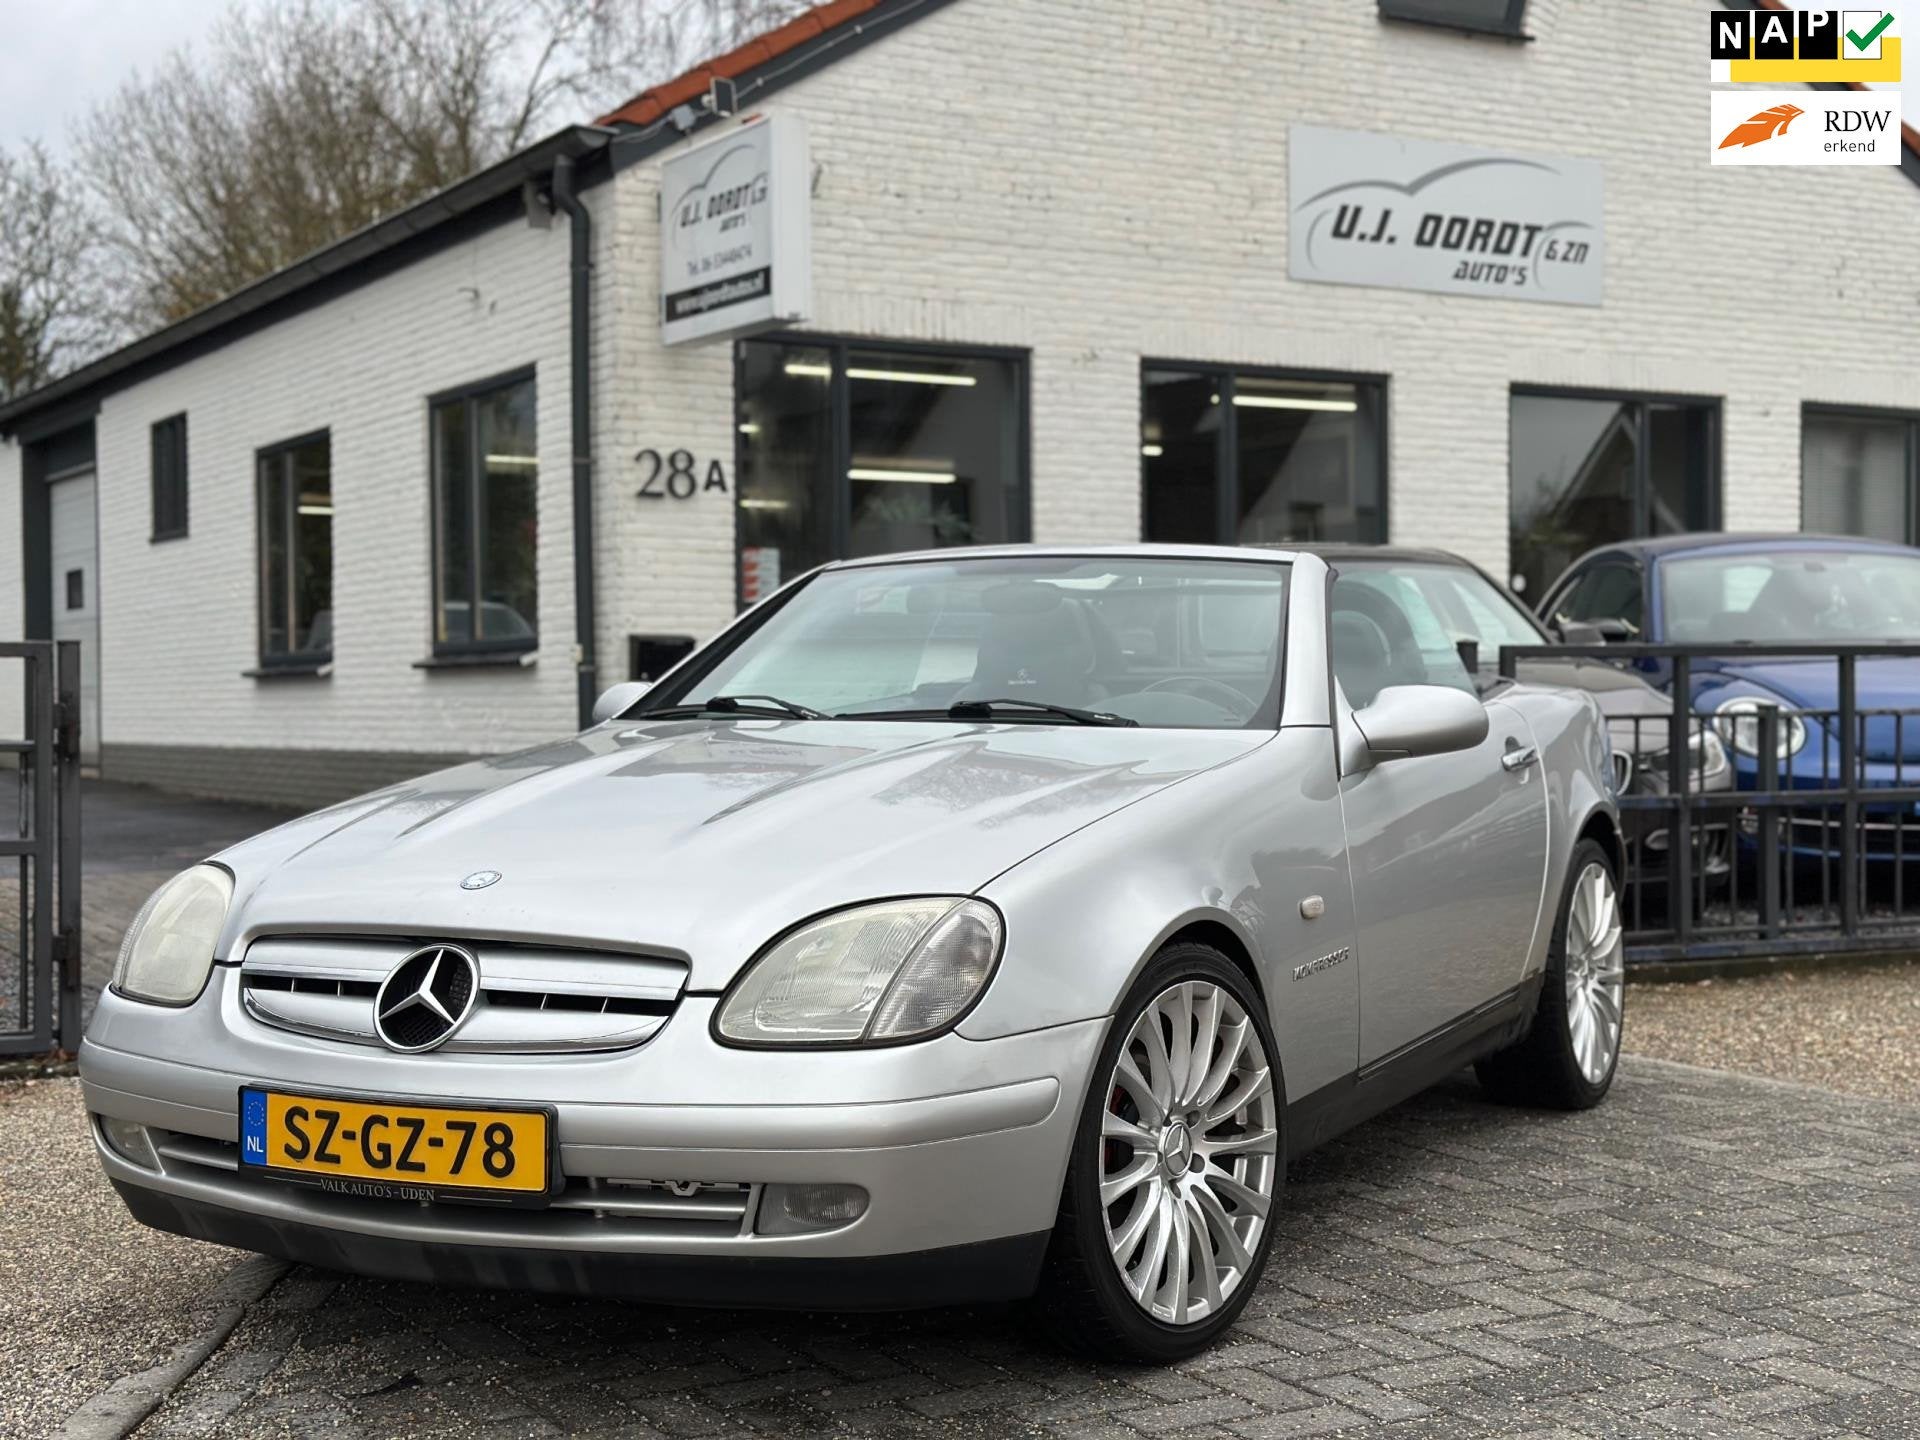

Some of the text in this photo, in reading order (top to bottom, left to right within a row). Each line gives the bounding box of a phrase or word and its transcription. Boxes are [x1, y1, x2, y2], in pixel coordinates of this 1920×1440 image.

[1331, 204, 1398, 245] U.J.
[1413, 212, 1544, 258] OORDT
[1452, 259, 1528, 286] AUTO'S
[246, 1135, 264, 1153] NL
[284, 1105, 515, 1179] SZ-GZ-78
[320, 1178, 349, 1194] VALK
[350, 1183, 392, 1198] AUTO'S
[400, 1187, 435, 1201] UDEN
